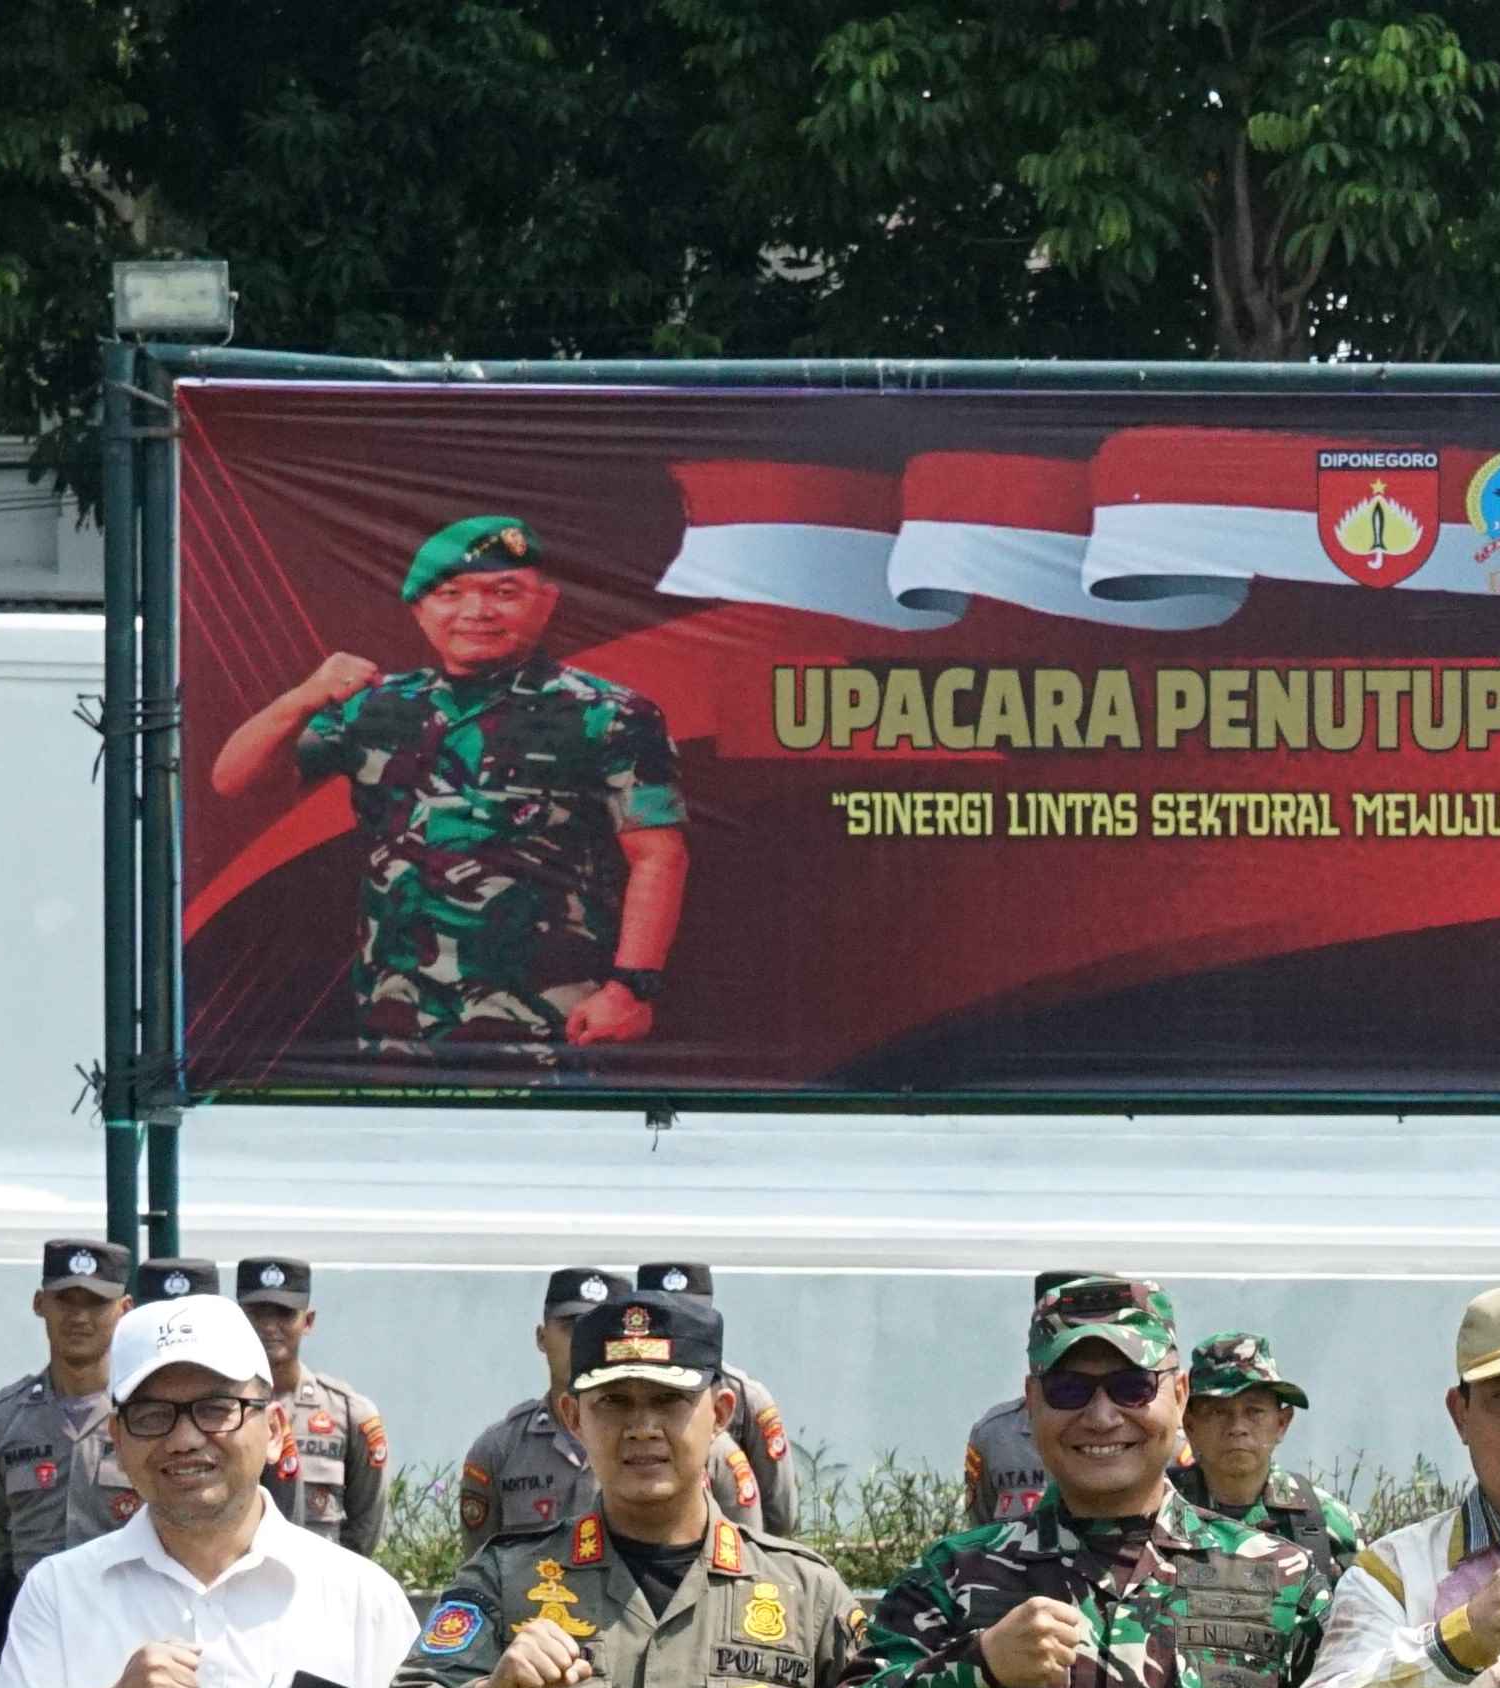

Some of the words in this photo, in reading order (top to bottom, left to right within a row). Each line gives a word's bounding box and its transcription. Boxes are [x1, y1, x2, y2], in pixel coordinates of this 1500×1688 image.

[1319, 452, 1438, 468] DIPONEGORO
[774, 666, 1142, 750] UPACARA
[1006, 792, 1138, 836] LINTAS
[1151, 792, 1341, 836] SEKTORAL
[1184, 1625, 1230, 1645] TNI
[716, 1648, 767, 1676] POL
[773, 1656, 810, 1682] PP
